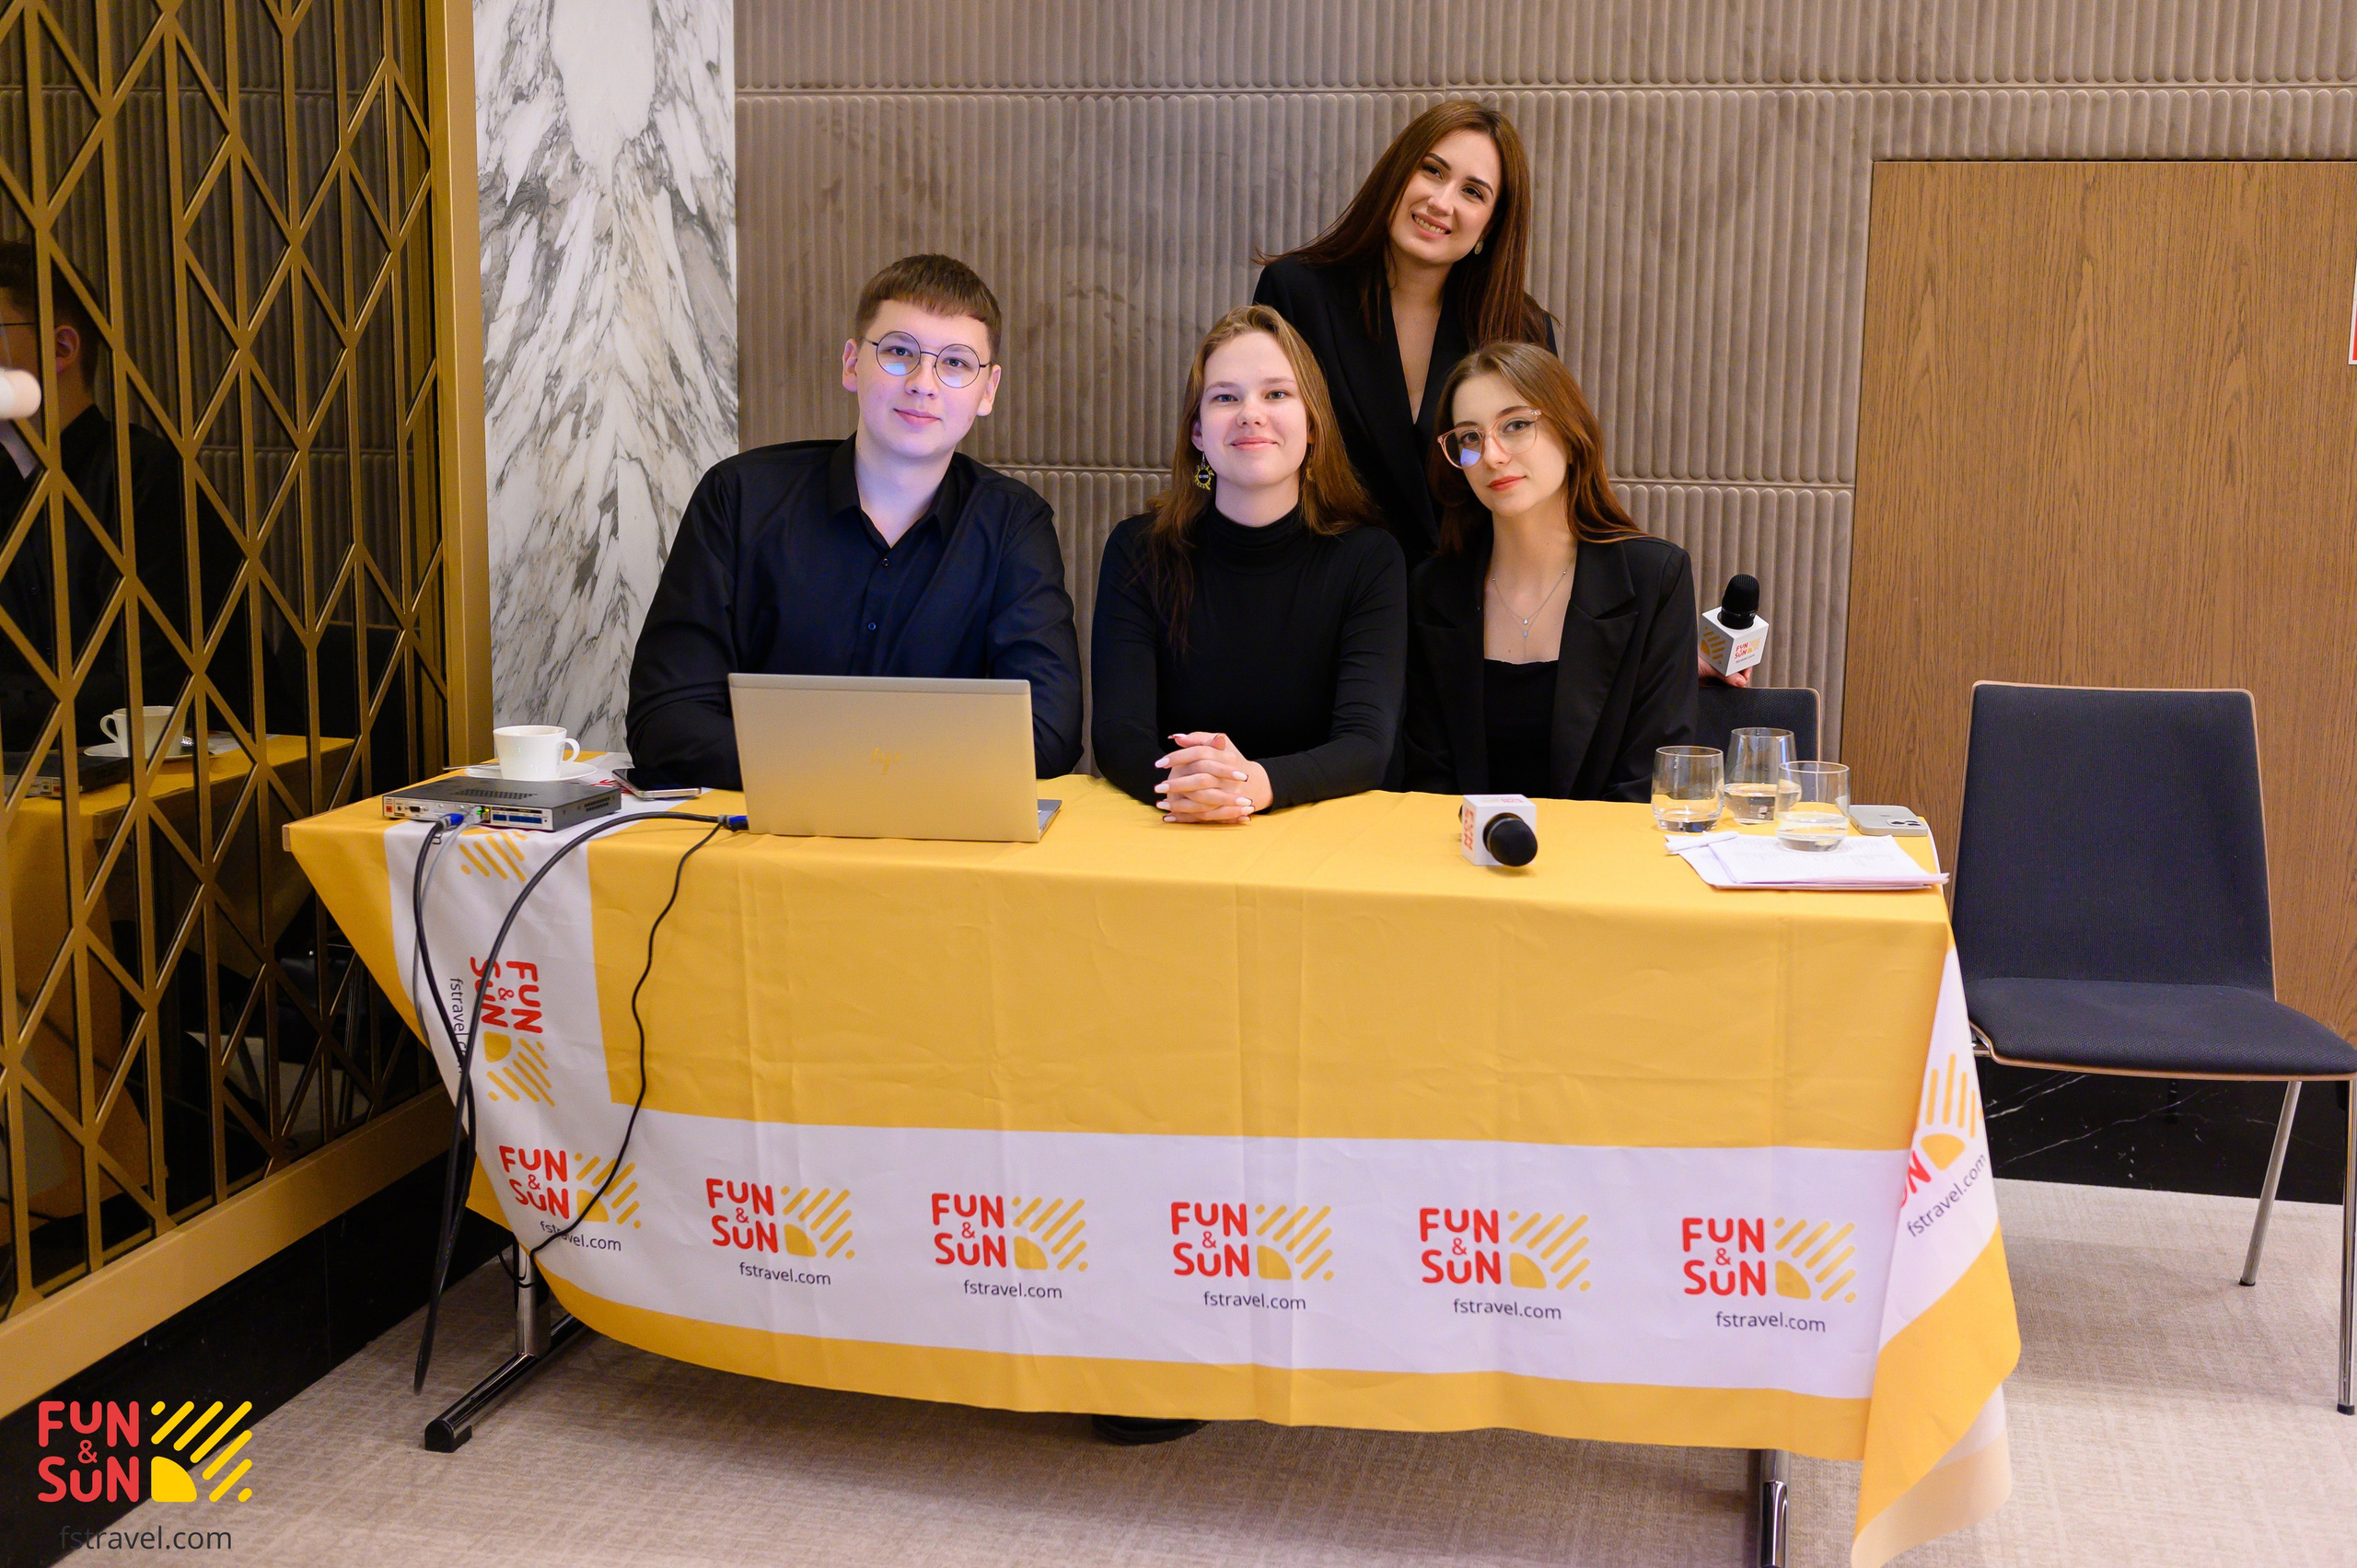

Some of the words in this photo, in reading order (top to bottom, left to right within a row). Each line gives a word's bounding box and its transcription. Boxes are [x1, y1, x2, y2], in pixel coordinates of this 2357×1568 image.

[498, 987, 515, 1001] &
[506, 960, 543, 1034] FUN
[498, 1144, 568, 1182] FUN
[508, 1179, 570, 1220] SUN
[528, 1174, 541, 1191] &
[704, 1178, 774, 1216] FUN
[1907, 1154, 1987, 1237] fstravel.com
[736, 1207, 749, 1224] &
[931, 1192, 1004, 1228] FUN
[1170, 1202, 1248, 1237] FUN
[1419, 1207, 1500, 1244] FUN
[711, 1214, 779, 1253] SUN
[961, 1222, 976, 1239] &
[1202, 1230, 1216, 1249] &
[1452, 1237, 1468, 1256] &
[1681, 1216, 1765, 1254] FUN
[934, 1232, 1006, 1268] SUN
[1173, 1242, 1250, 1278] SUN
[1422, 1249, 1502, 1285] SUN
[1715, 1248, 1731, 1266] &
[738, 1262, 831, 1285] fstravel.com
[963, 1279, 1062, 1299] fstravel.com
[1683, 1259, 1767, 1296] SUN
[1203, 1291, 1306, 1310] fstravel.com
[1453, 1298, 1562, 1319] fstravel.com
[1715, 1311, 1826, 1332] fstravel.com
